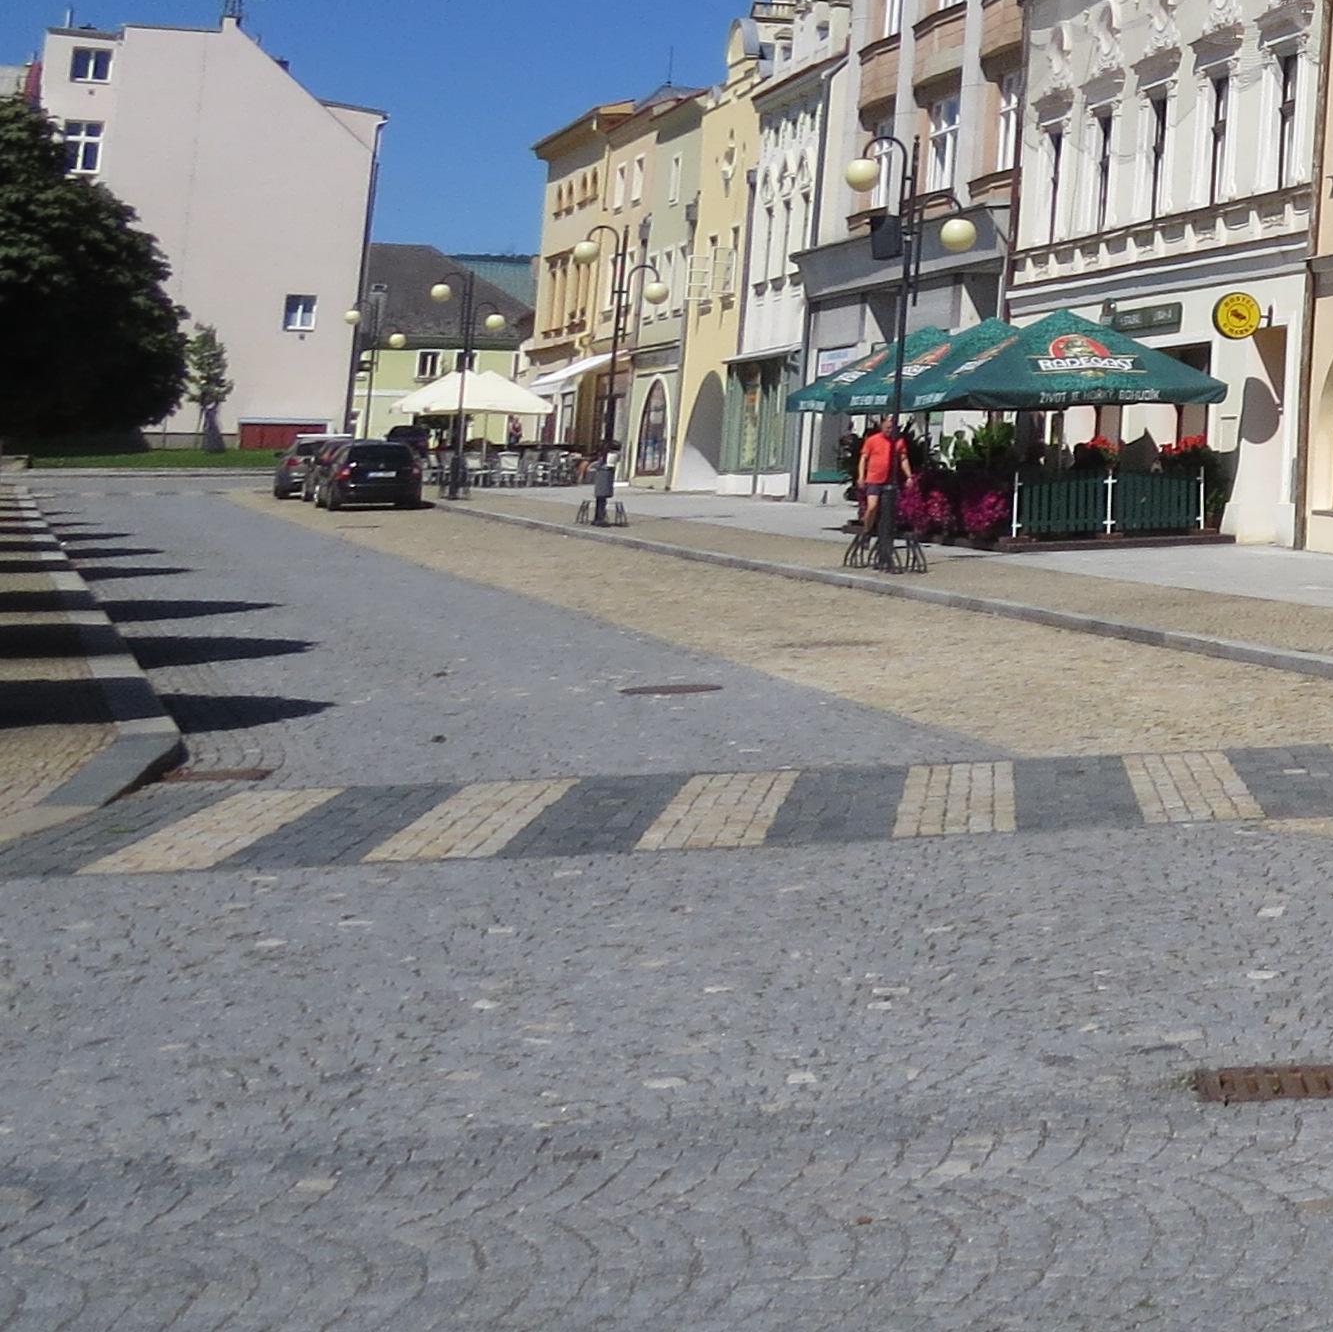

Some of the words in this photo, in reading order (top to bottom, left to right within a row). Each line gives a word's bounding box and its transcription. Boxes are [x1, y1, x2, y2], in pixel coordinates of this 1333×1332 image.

[1224, 296, 1255, 308] HOSTEL
[1037, 356, 1135, 371] RADEGAST
[1039, 391, 1067, 404] ŽIVOT
